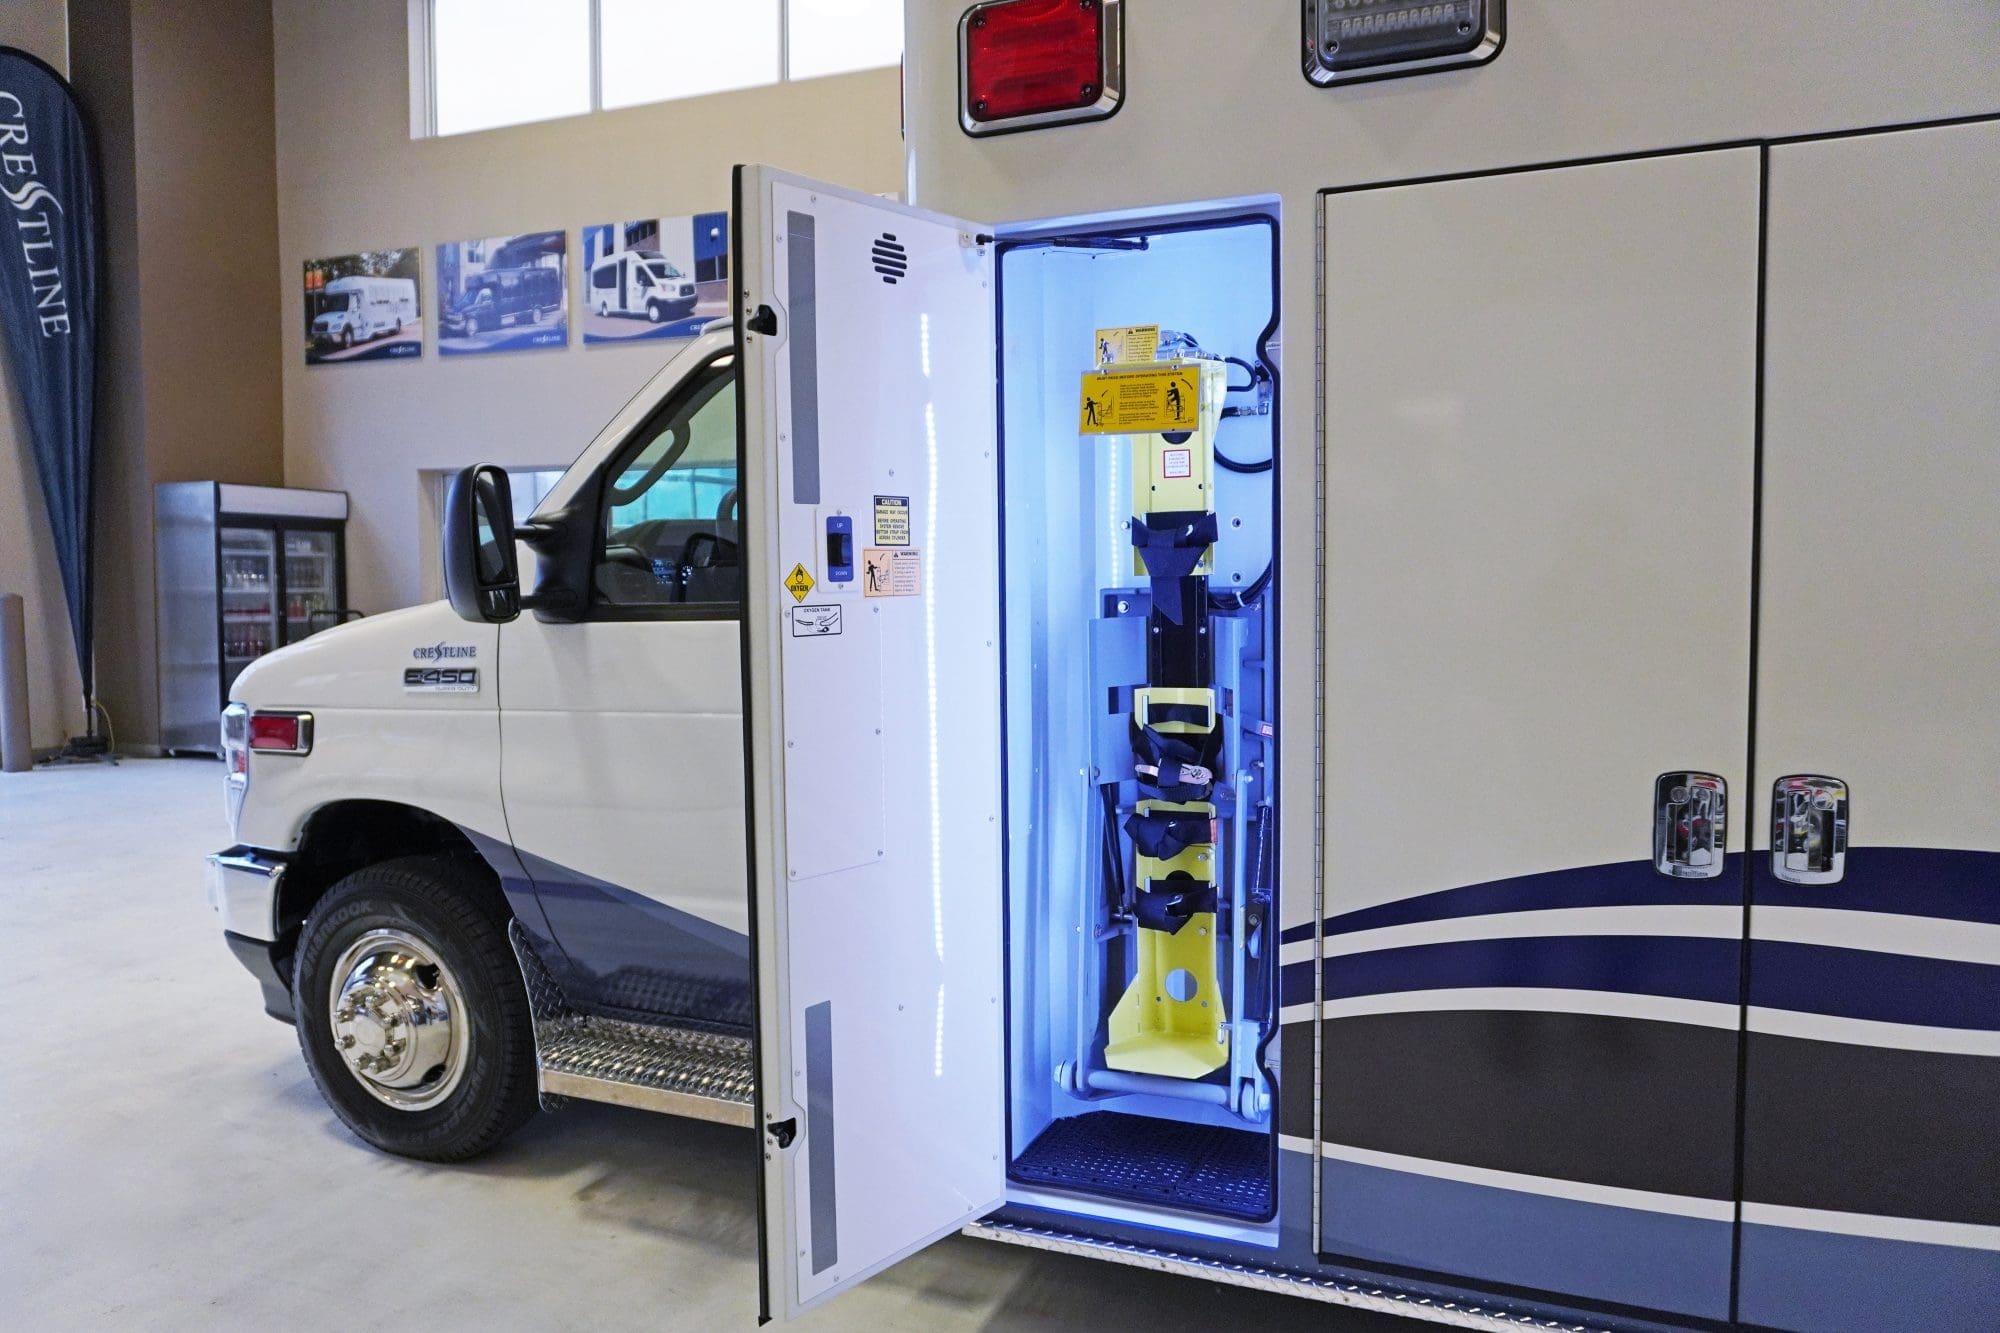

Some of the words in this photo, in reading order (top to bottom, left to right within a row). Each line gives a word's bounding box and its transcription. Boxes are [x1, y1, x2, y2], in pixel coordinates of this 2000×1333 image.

[0, 91, 71, 338] CRESTLINE
[790, 584, 809, 592] OXYGEN
[413, 641, 477, 662] CRESTLINE
